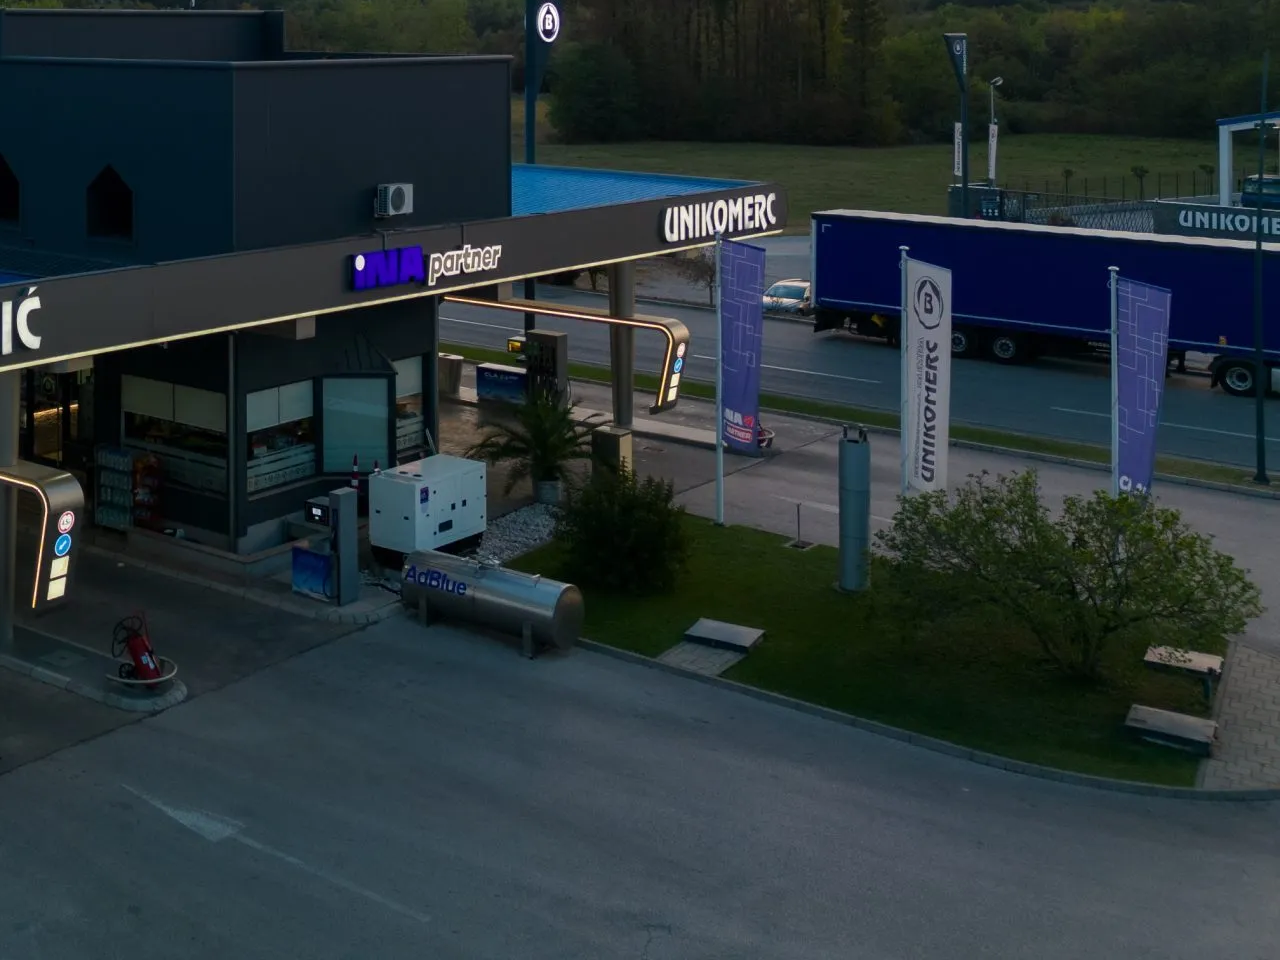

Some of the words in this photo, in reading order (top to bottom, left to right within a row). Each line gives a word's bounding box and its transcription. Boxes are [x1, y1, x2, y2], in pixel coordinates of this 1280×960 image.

[664, 192, 776, 243] UNIKOMERC
[428, 244, 502, 286] partner
[921, 339, 940, 484] UNIKOMERC
[404, 564, 467, 596] AdBlue
